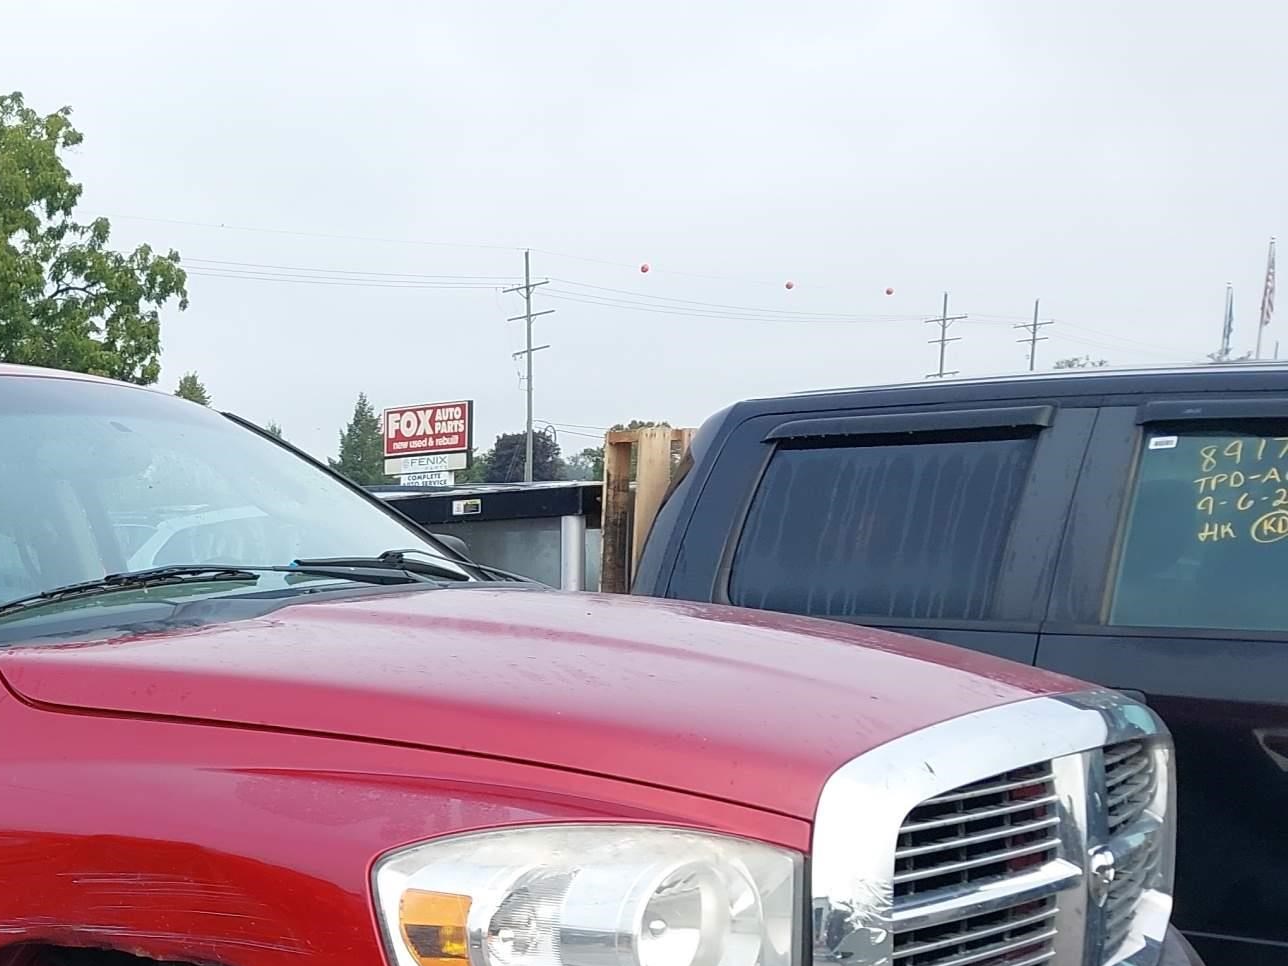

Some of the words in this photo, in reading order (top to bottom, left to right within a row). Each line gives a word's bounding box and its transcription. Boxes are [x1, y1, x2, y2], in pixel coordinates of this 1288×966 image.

[435, 407, 462, 420] AUTO
[388, 410, 433, 439] FOX
[435, 420, 464, 433] PARTS
[393, 441, 409, 449] new
[410, 438, 428, 448] used
[428, 438, 434, 446] &
[436, 435, 459, 446] rebuilt
[411, 456, 448, 466] FENIX
[407, 473, 442, 482] COMPLETE
[1193, 467, 1288, 494] TPD-A
